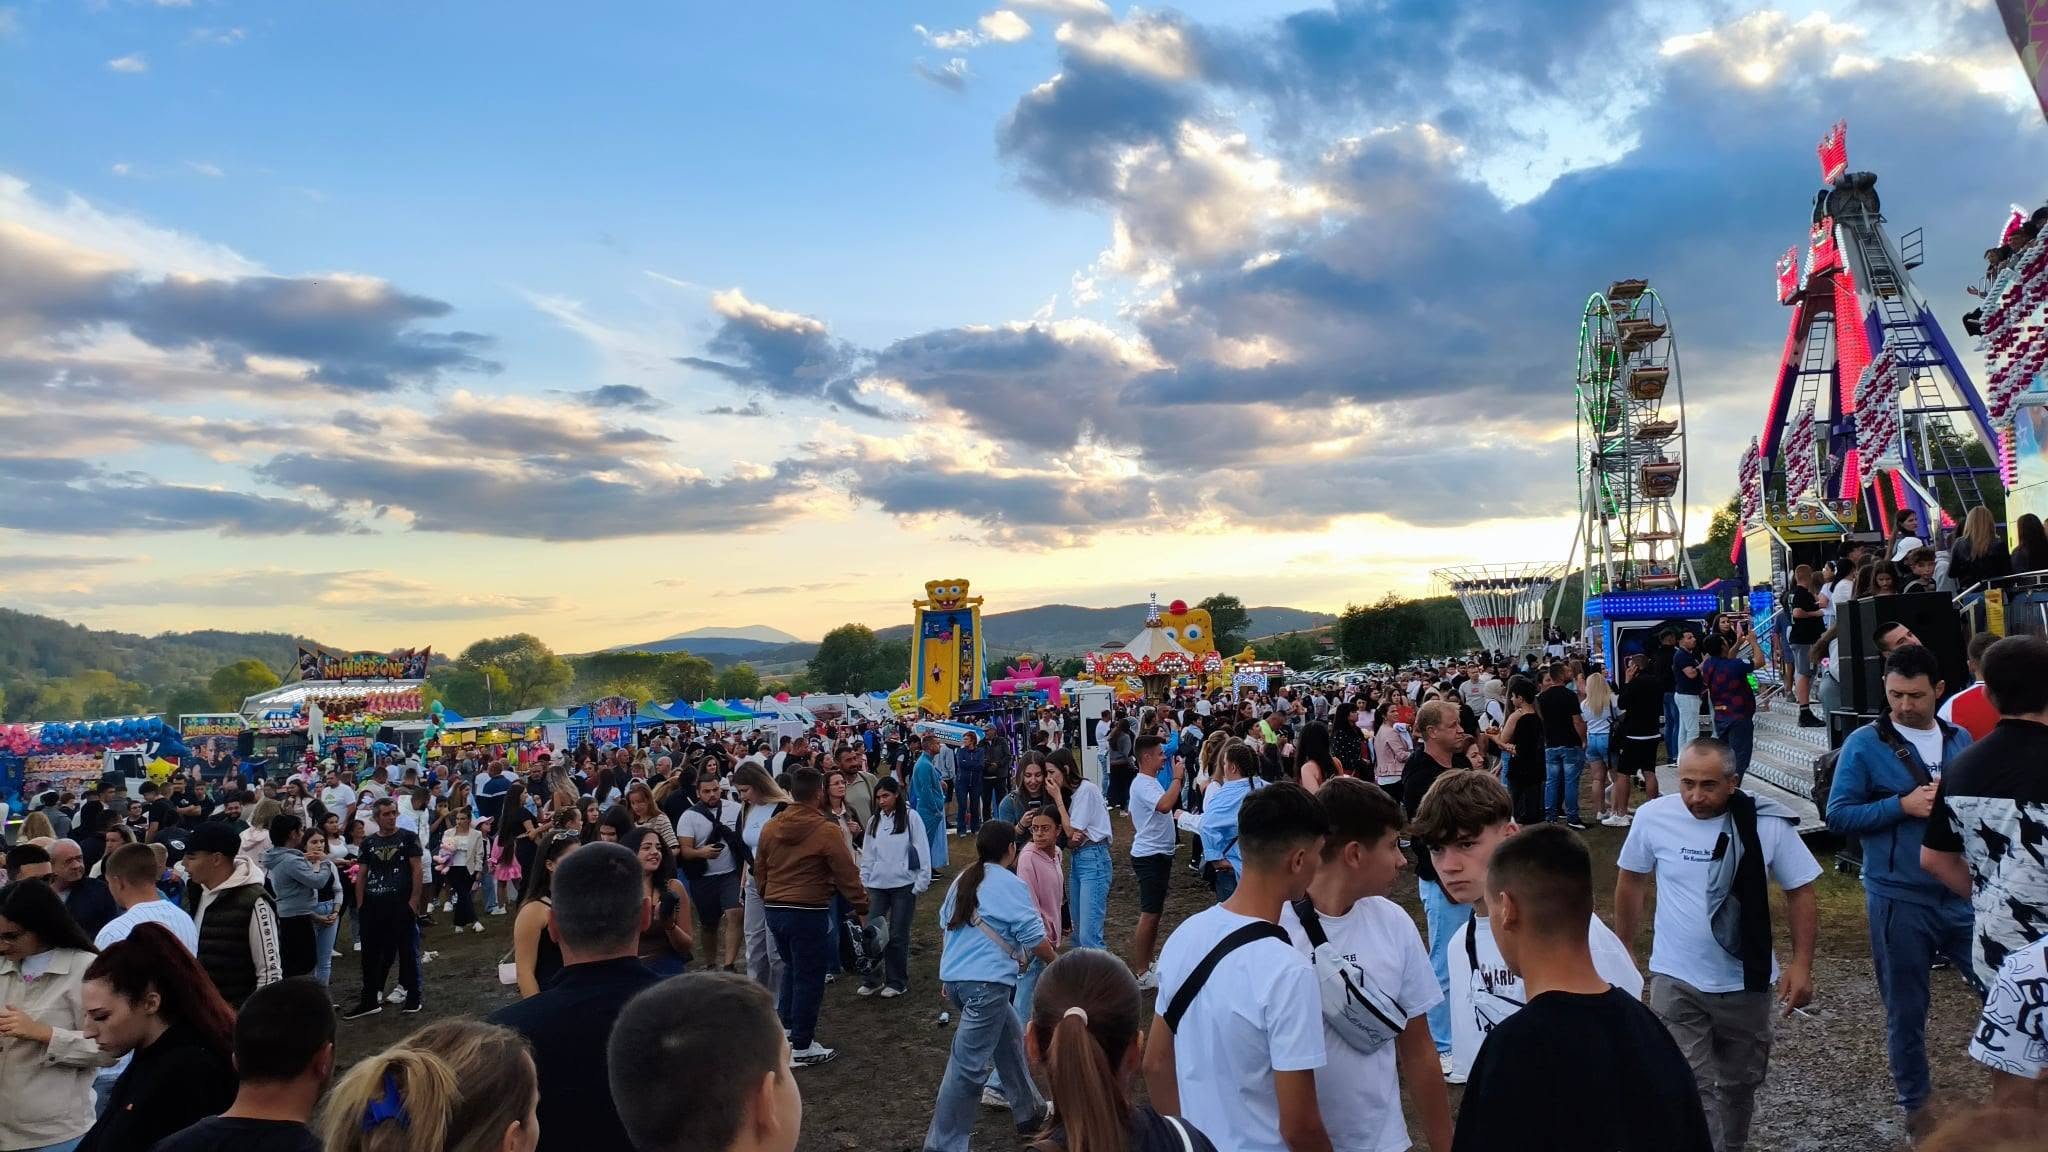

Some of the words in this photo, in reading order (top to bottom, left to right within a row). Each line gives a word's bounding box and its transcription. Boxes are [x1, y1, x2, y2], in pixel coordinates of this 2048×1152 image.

[325, 661, 377, 678] NUMBER
[381, 662, 404, 678] ONE
[258, 903, 269, 926] ICON
[266, 938, 276, 961] ICON
